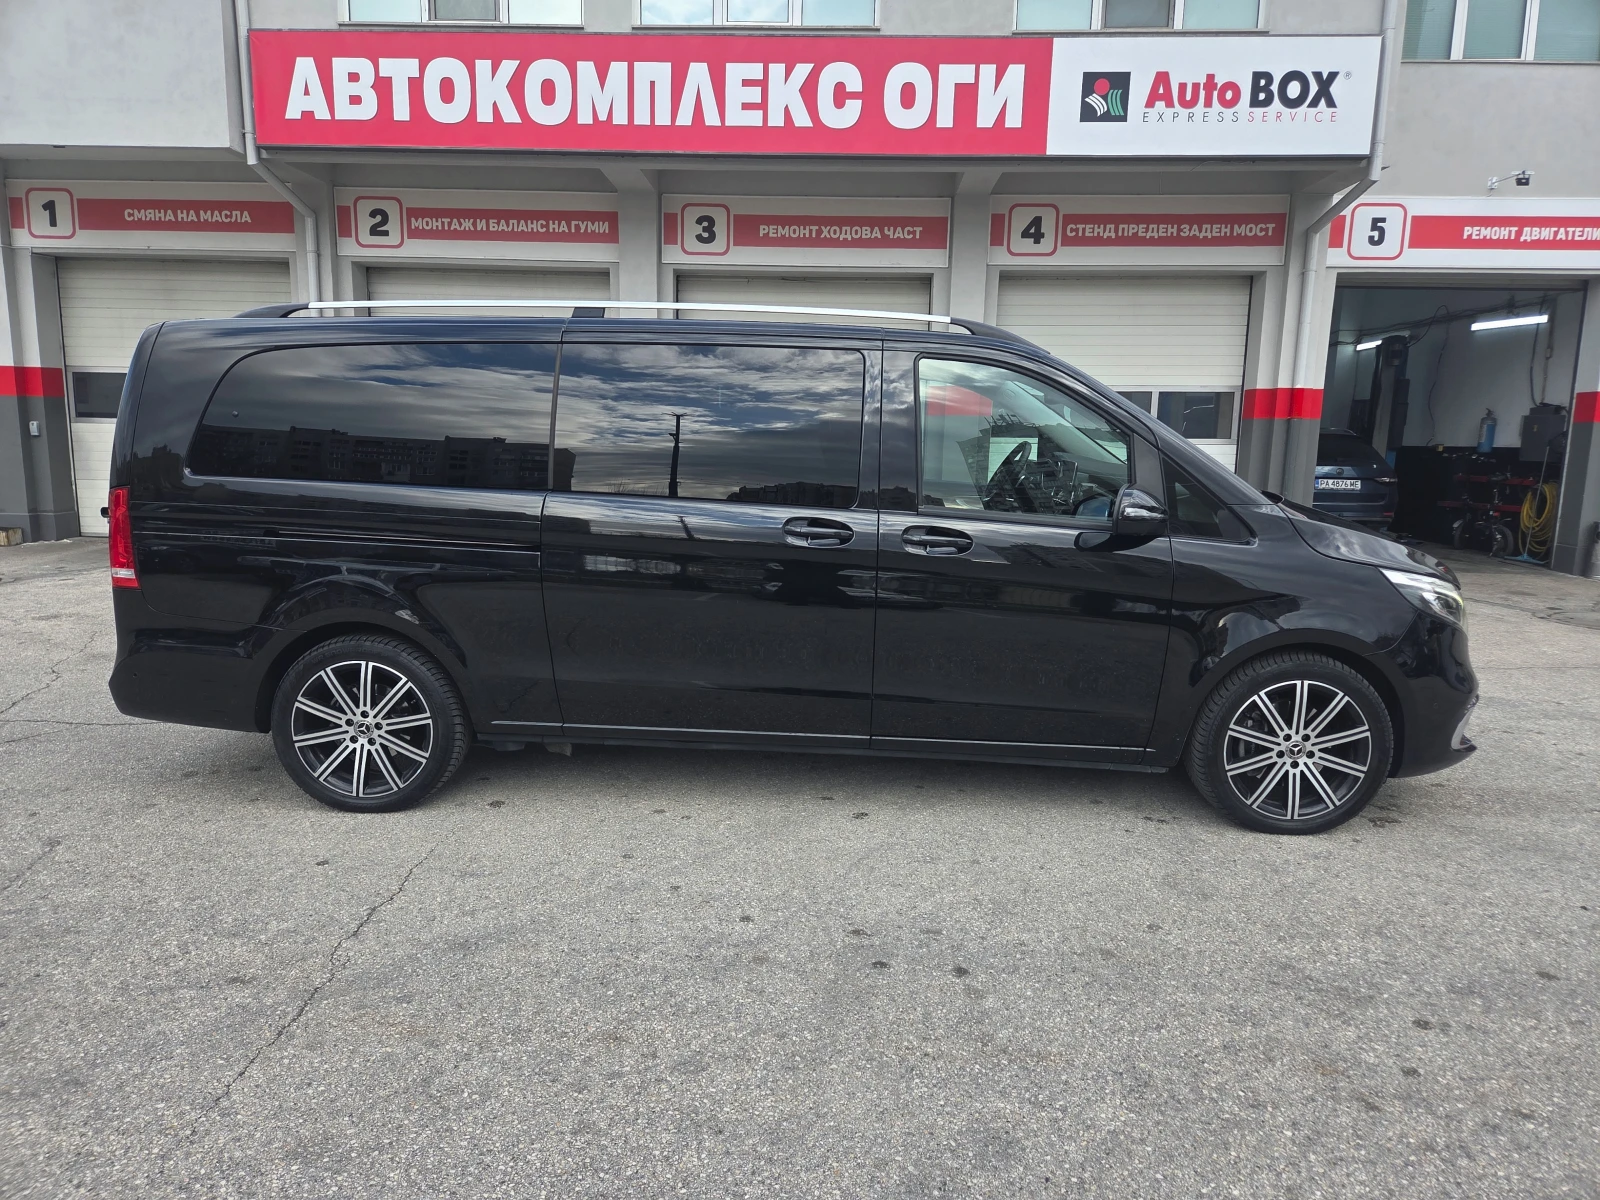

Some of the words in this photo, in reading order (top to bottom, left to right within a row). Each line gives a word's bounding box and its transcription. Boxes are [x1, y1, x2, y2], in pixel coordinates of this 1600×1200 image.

[285, 57, 862, 129] АВТОКОМПЛЕКС
[883, 61, 1026, 130] ОГИ
[1144, 70, 1242, 110] Auto
[1248, 69, 1340, 110] BOX
[1142, 111, 1240, 123] EXPRESS
[1247, 111, 1338, 123] SERVICE
[41, 199, 58, 228] 1
[124, 208, 176, 222] СМЯНА
[177, 209, 198, 222] НА
[199, 210, 252, 223] МАСЛА
[368, 207, 390, 237] 2
[410, 217, 475, 231] МОНТАЖ
[476, 218, 487, 231] И
[489, 218, 547, 233] БАЛАНС
[549, 220, 569, 233] НА
[571, 220, 609, 234] ГУМИ
[694, 214, 717, 245] 3
[759, 224, 819, 239] РЕМОНТ
[820, 225, 882, 241] ХОДОВА
[884, 226, 923, 239] ЧАСТ
[1020, 215, 1046, 245] 4
[1066, 224, 1116, 239] СТЕНД
[1118, 224, 1178, 239] ПРЕДЕН
[1179, 224, 1231, 239] ЗАДЕН
[1233, 223, 1276, 237] МОСТ
[1367, 217, 1387, 247] 5
[1462, 226, 1519, 240] РЕМОНТ
[1519, 227, 1600, 242] ДВИГАТЕЛИ
